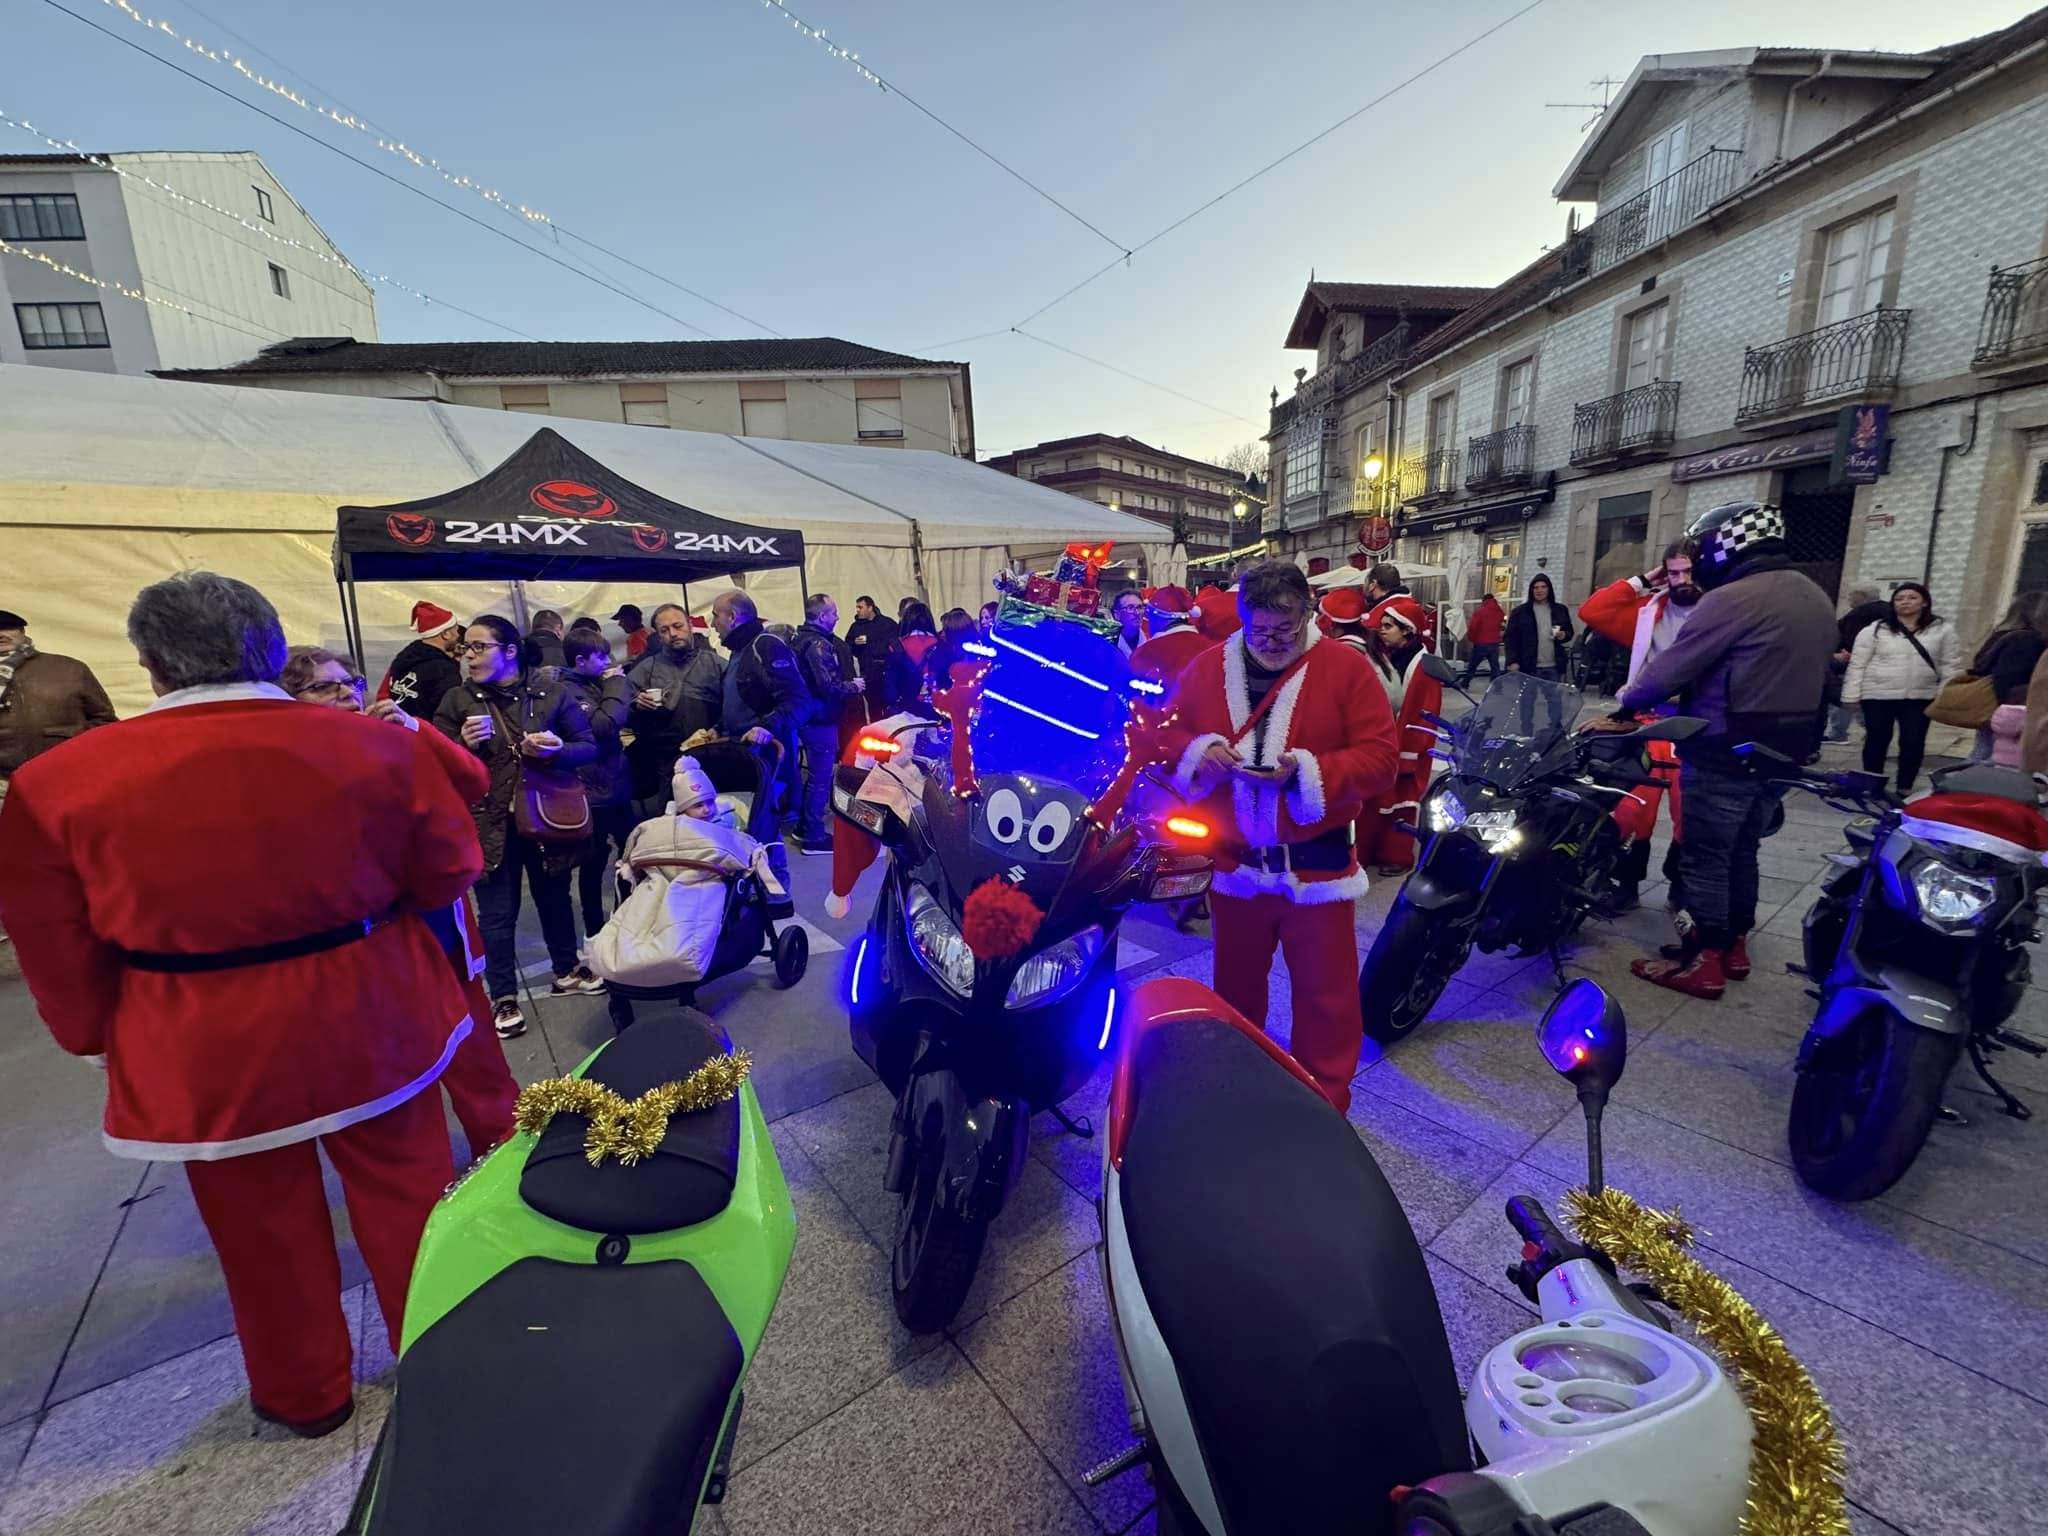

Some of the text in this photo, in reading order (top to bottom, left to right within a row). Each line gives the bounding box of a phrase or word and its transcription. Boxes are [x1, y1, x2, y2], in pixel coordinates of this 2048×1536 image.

[1687, 444, 1800, 474] Ninfa
[444, 520, 588, 547] 24MX
[517, 514, 656, 528] 24MX
[674, 531, 781, 556] 24MX
